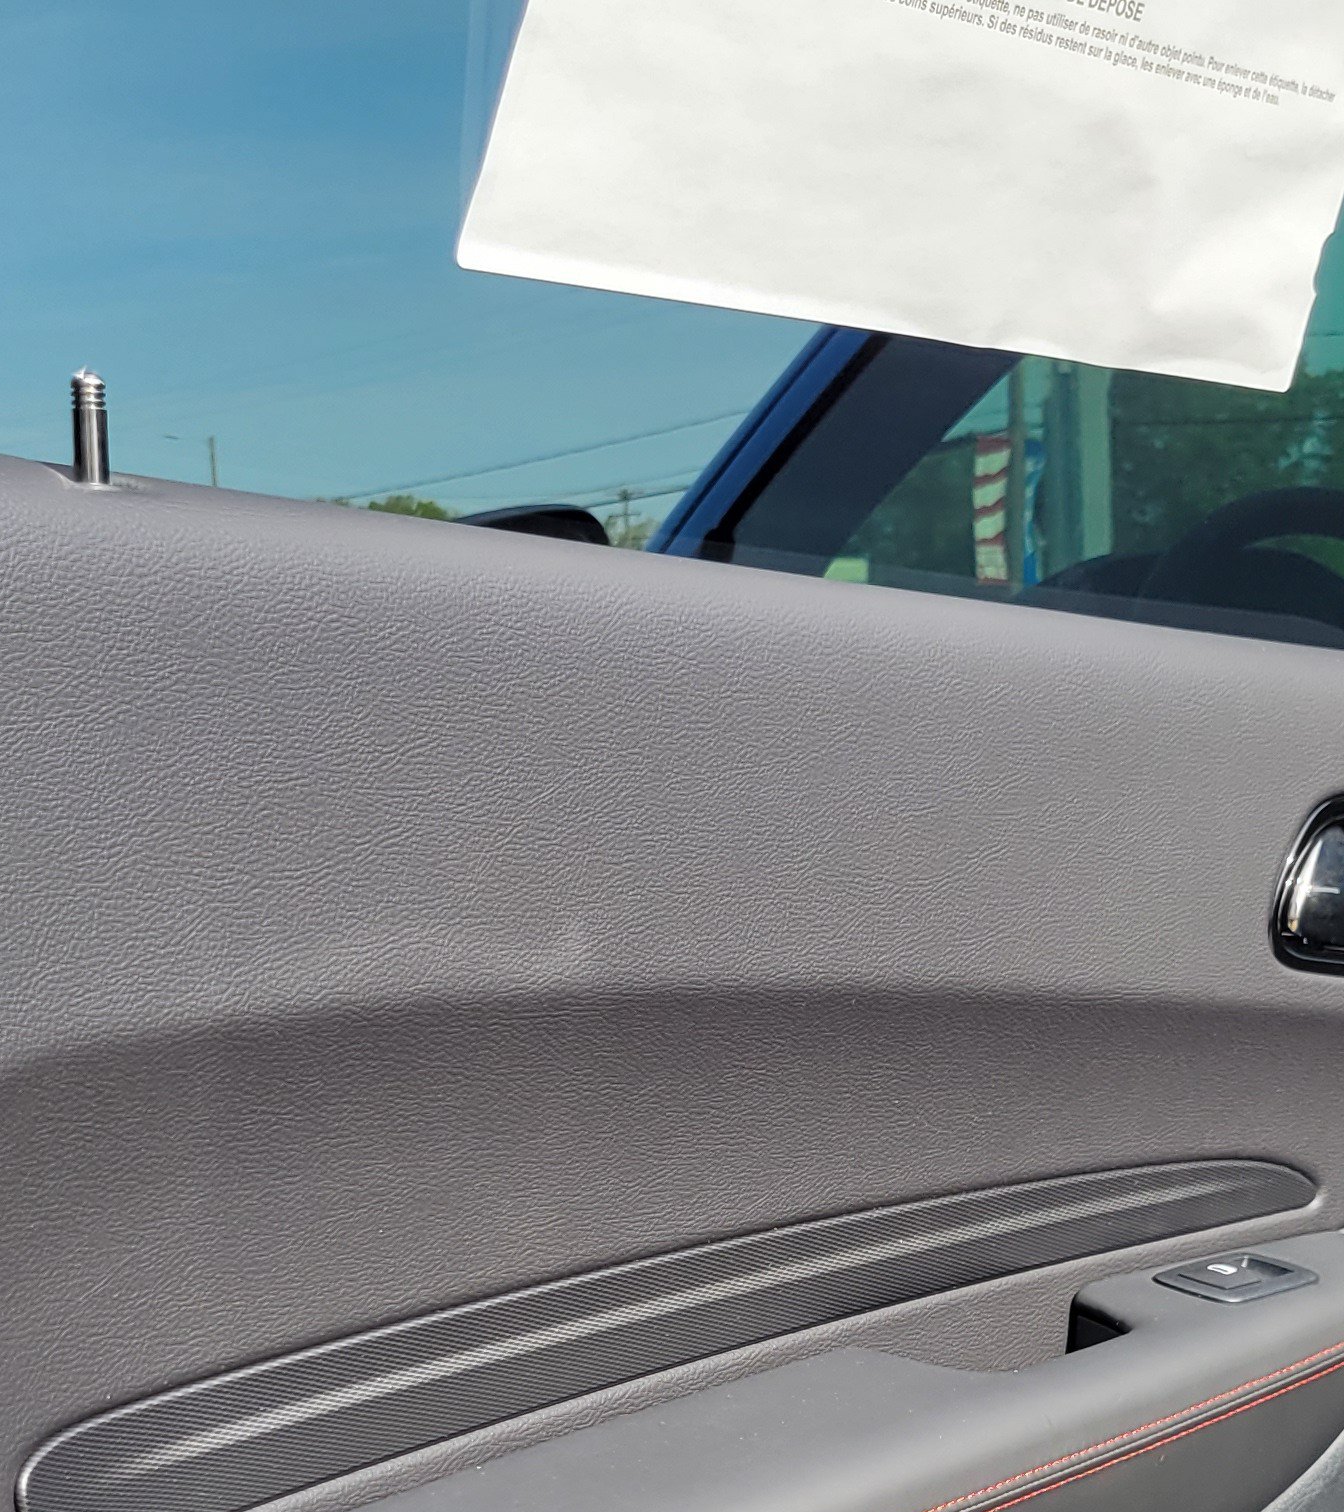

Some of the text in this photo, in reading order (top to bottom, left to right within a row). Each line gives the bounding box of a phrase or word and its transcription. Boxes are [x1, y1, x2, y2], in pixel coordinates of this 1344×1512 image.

[929, 2, 984, 27] supérieurs.
[987, 14, 999, 30] Si
[999, 18, 1017, 35] des
[1018, 24, 1054, 45] résidus
[1055, 35, 1087, 54] restent
[1087, 45, 1104, 58] sur
[1103, 46, 1113, 61] la
[1112, 50, 1138, 69] glace,
[1140, 56, 1154, 72] les
[1154, 63, 1185, 80] enlever
[1013, 4, 1026, 17] ne
[1026, 7, 1045, 22] pas
[1046, 13, 1078, 31] utiliser
[1079, 20, 1090, 36] de
[1091, 26, 1118, 42] rasoir
[1118, 32, 1129, 46] ni
[1160, 44, 1182, 62] objet
